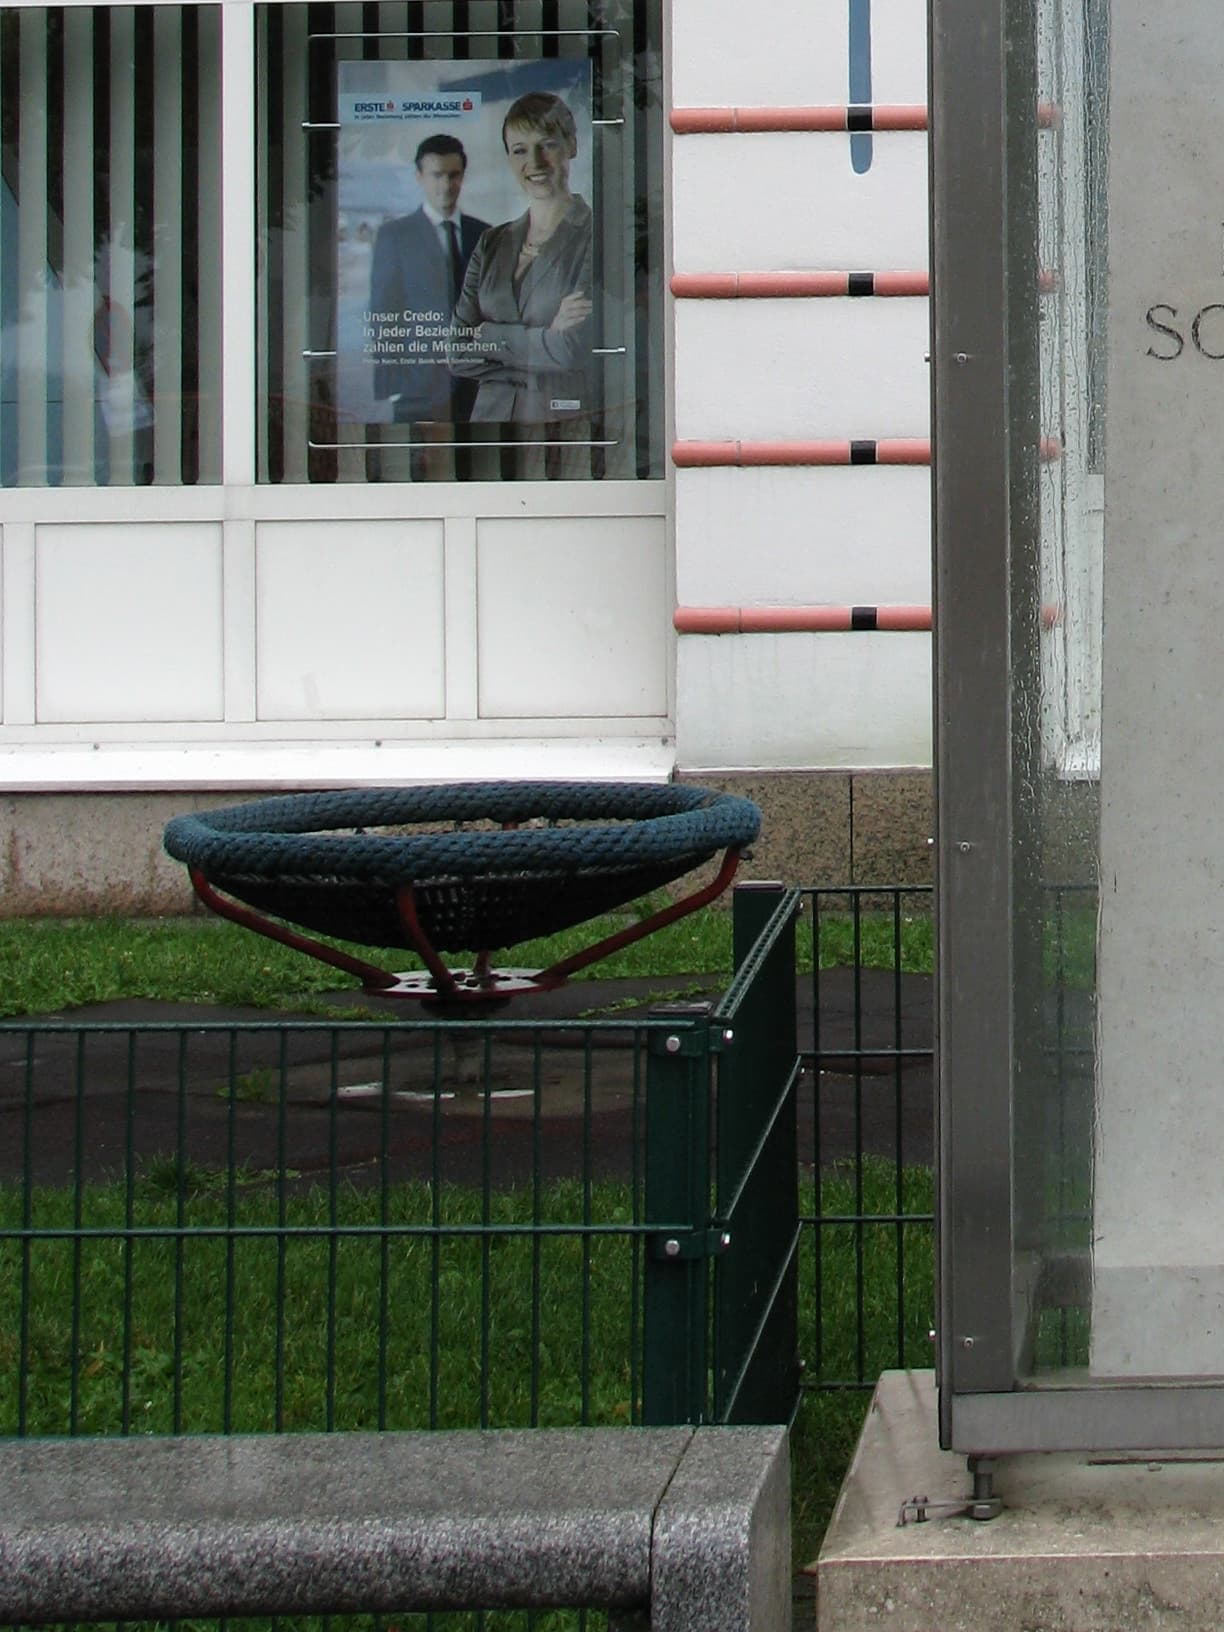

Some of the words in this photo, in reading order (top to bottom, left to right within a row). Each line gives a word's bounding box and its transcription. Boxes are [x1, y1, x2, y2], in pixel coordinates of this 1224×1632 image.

[354, 102, 385, 112] ERSTE
[402, 101, 461, 112] SPARKASSE
[363, 311, 400, 322] Unser
[403, 310, 444, 322] Credo:
[363, 327, 375, 337] In
[378, 325, 412, 340] jeder
[415, 324, 482, 338] Beziehung
[408, 340, 428, 353] die
